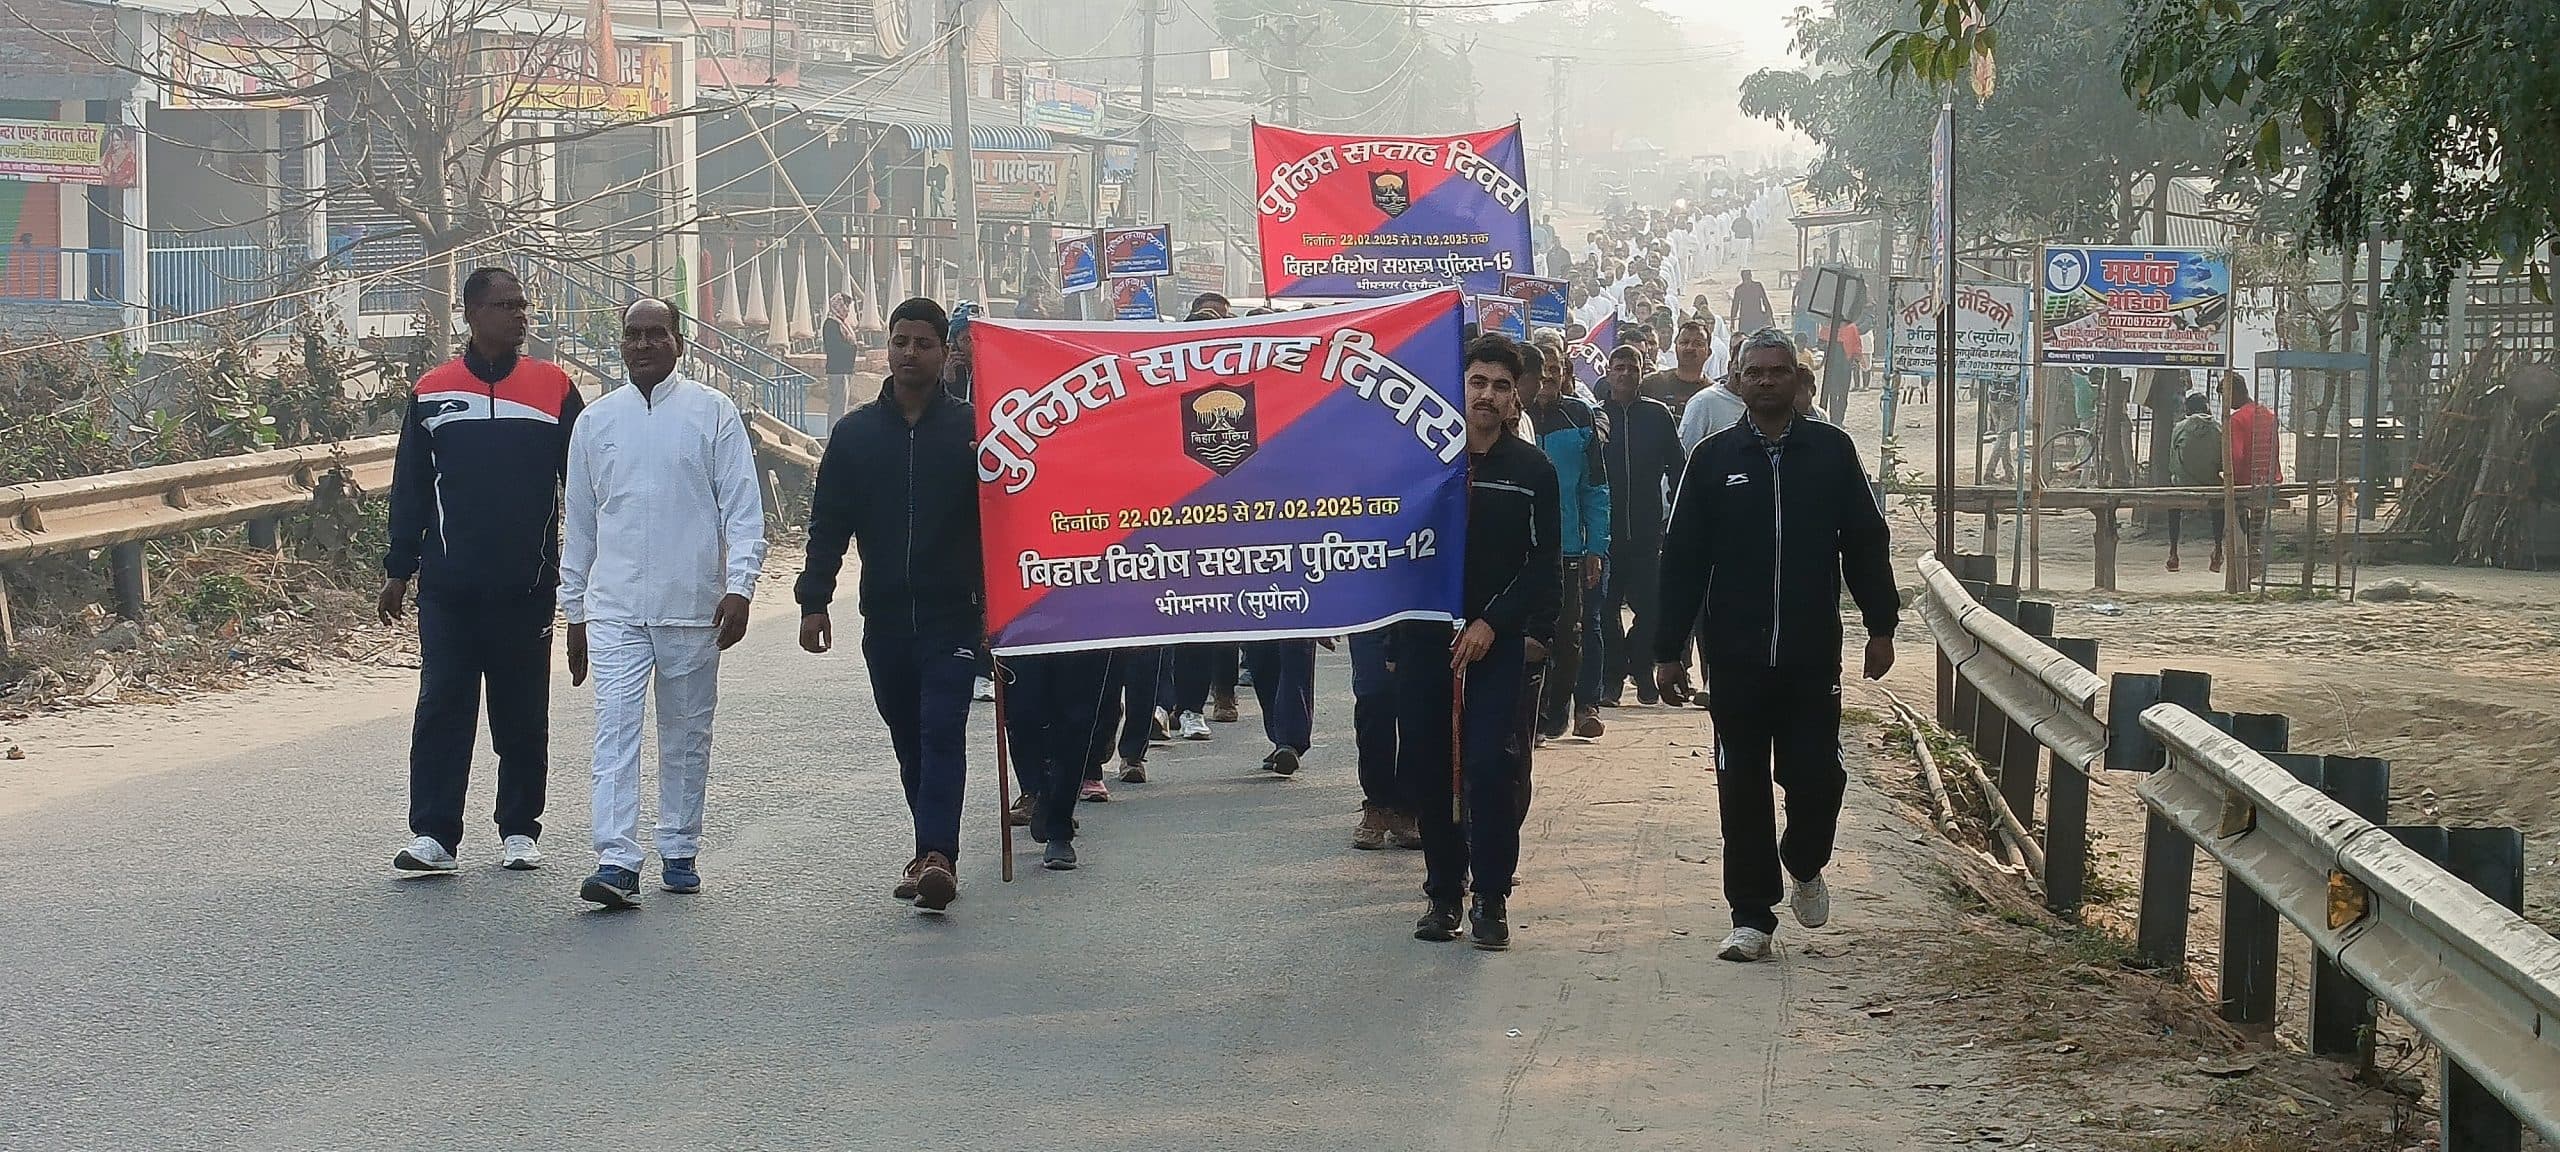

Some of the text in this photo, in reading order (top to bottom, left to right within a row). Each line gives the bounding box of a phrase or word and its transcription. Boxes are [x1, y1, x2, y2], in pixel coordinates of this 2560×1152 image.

[1258, 139, 1528, 223] पुलिस सप्ताह दिवस
[1470, 233, 1490, 246] तक
[1282, 254, 1330, 276] बिहार
[1331, 251, 1378, 275] विशेष
[1382, 256, 1434, 275] सशस्त्र
[2101, 253, 2179, 287] मयंक
[1956, 285, 2014, 329] मेडिको
[2106, 288, 2171, 312] मेडिको
[1967, 327, 2015, 347] (सुपौल)
[977, 327, 1467, 495] पुलिस सप्ताह दिवस
[1191, 430, 1217, 444] बिहार
[1051, 496, 1401, 533] दिनांक 22.02.2025 से 27.02.2025 तक
[1018, 550, 1102, 589] बिहार
[1105, 543, 1190, 584] विशेष
[1195, 544, 1294, 577] सशस्त्र
[1154, 583, 1310, 619] भीमनगर (सुपौल)
